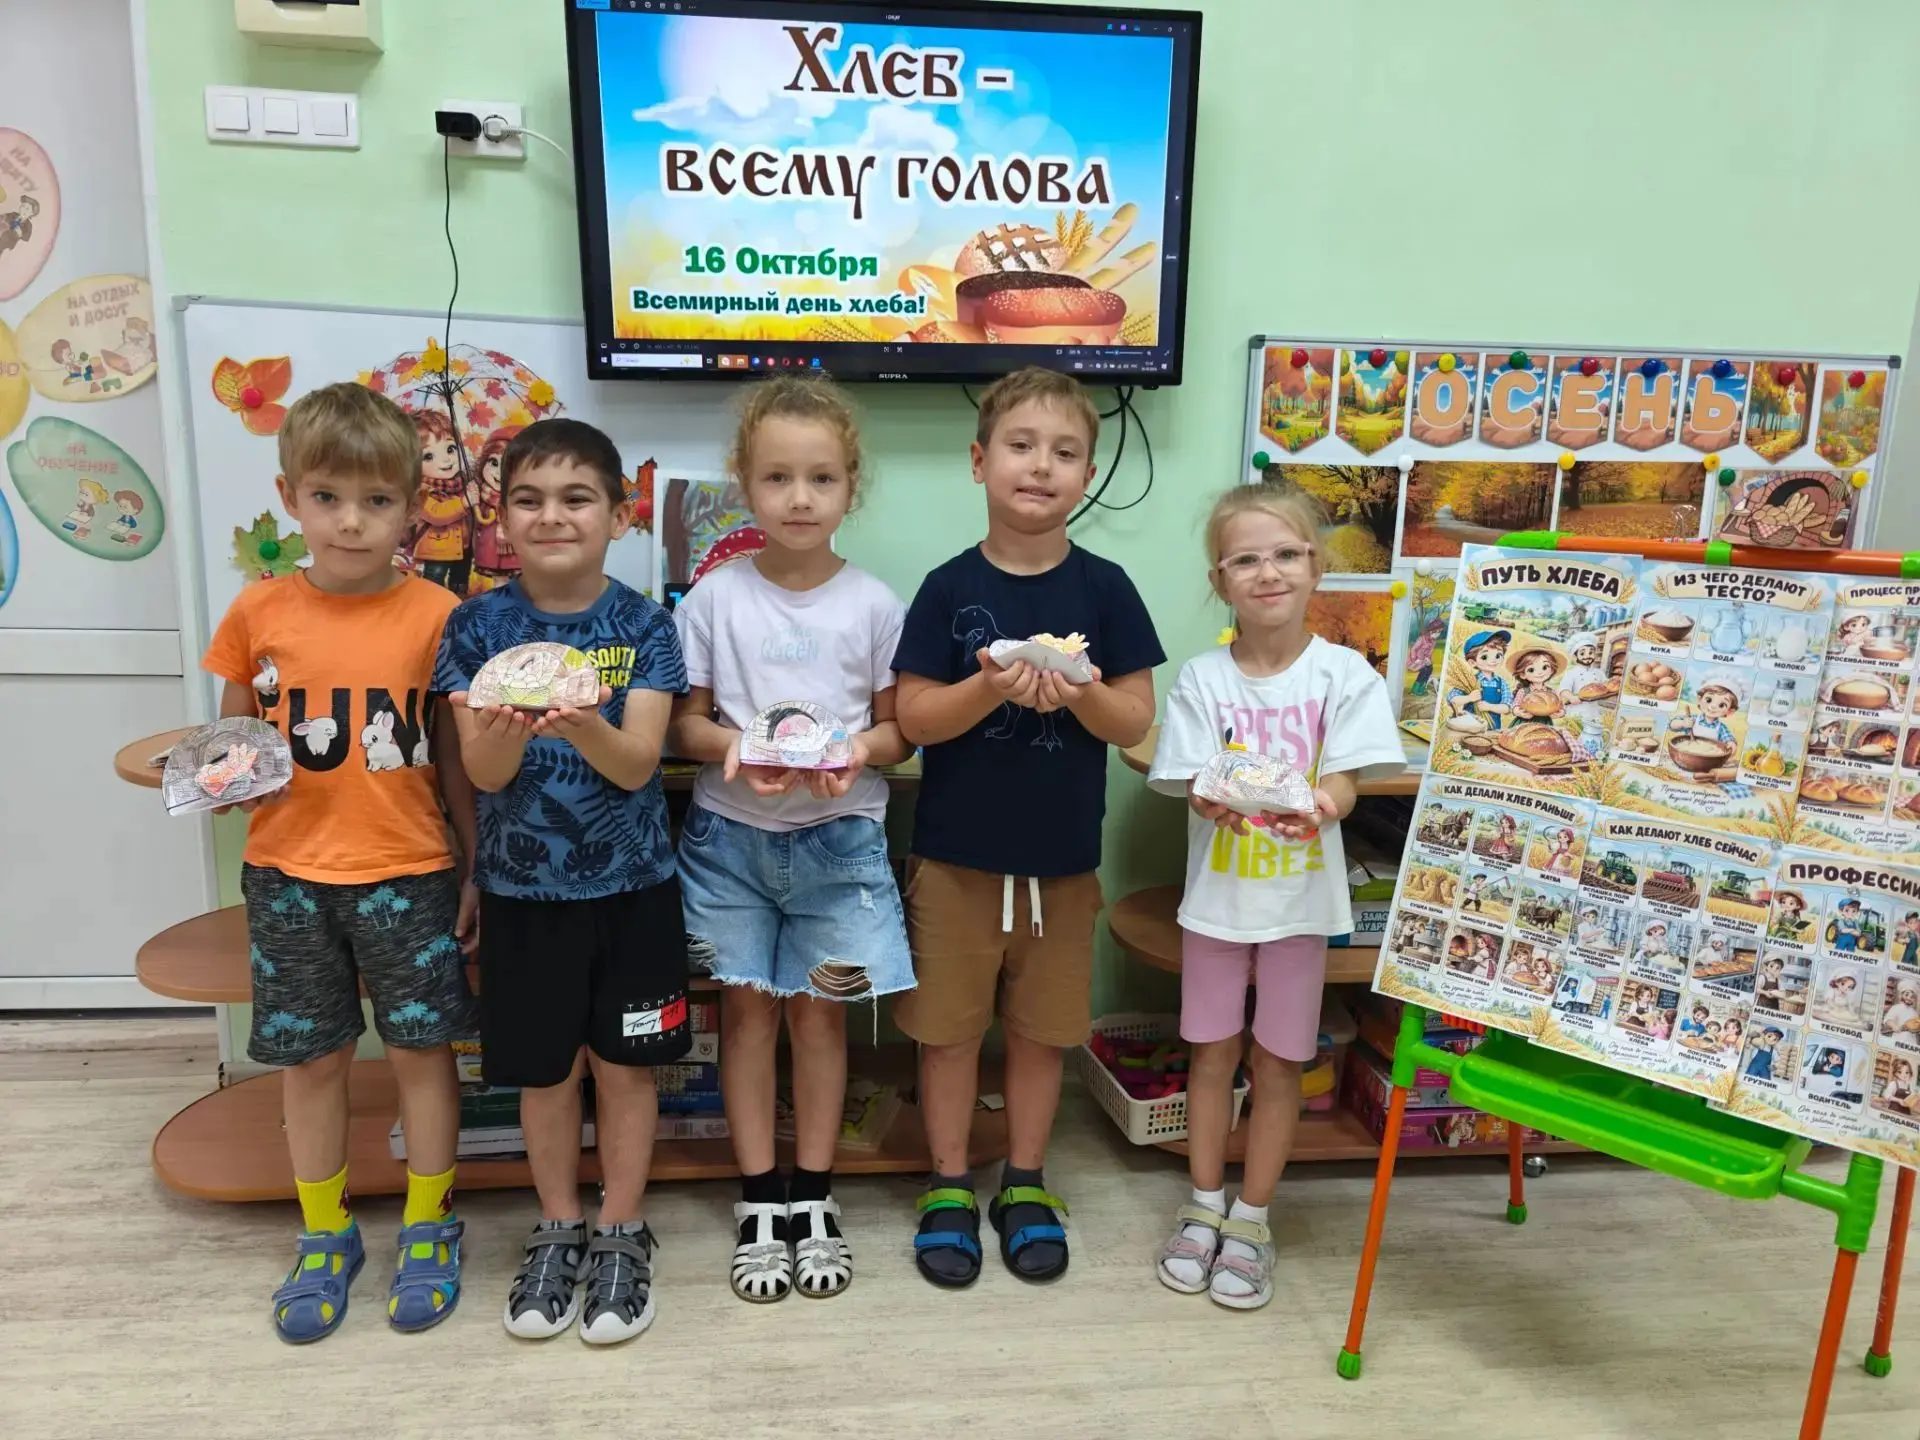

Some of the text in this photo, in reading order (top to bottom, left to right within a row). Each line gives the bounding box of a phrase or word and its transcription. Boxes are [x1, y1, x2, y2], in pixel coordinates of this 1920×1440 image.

[684, 246, 879, 278] 16 Октября
[67, 282, 140, 309] НА ОТДЫХ
[632, 289, 926, 314] Всемирный день хлеба!
[69, 303, 129, 327] И ДОСУГ
[1416, 368, 1737, 434] ОСЕНЬ
[66, 442, 88, 455] НА
[36, 456, 119, 474] ОБУЧЕНИЕ
[1481, 565, 1619, 598] ПУТЬ ХЛЕБА
[1674, 572, 1807, 597] ИЗ ЧЕГО ДЕЛАЮТ
[1705, 585, 1776, 604] ТЕСТО?
[1850, 586, 1902, 598] ПРОЦЕСС
[1651, 646, 1671, 654] МУКА
[1712, 654, 1735, 663] ВОДА
[1774, 661, 1806, 672] МОЛОКО
[1859, 710, 1880, 718] ТЕСТА
[1768, 719, 1788, 728] СОЛЬ
[1618, 753, 1651, 764] ДРОЖЖИ
[1744, 773, 1792, 787] РАСТИТЕЛЬНОЕ
[1756, 781, 1779, 790] МАСЛО
[1445, 785, 1575, 821] КАК ДЕЛАЛИ ХЛЕБ РАНЬШЕ
[1610, 824, 1758, 862] КАК ДЕЛАЮТ ХЛЕБ СЕЙЧАС
[1790, 864, 1920, 900] ПРОФЕССИИ
[1765, 938, 1803, 950] АГРОНОМ
[1829, 951, 1879, 965] ТРАКТОРИСТ
[1754, 1008, 1792, 1021] МЕЛЬНИК
[1821, 1024, 1862, 1039] ТЕСТОВОД
[1744, 1076, 1777, 1089] ГРУЗЧИК
[1808, 1093, 1851, 1109] ВОДИТЕЛЬ
